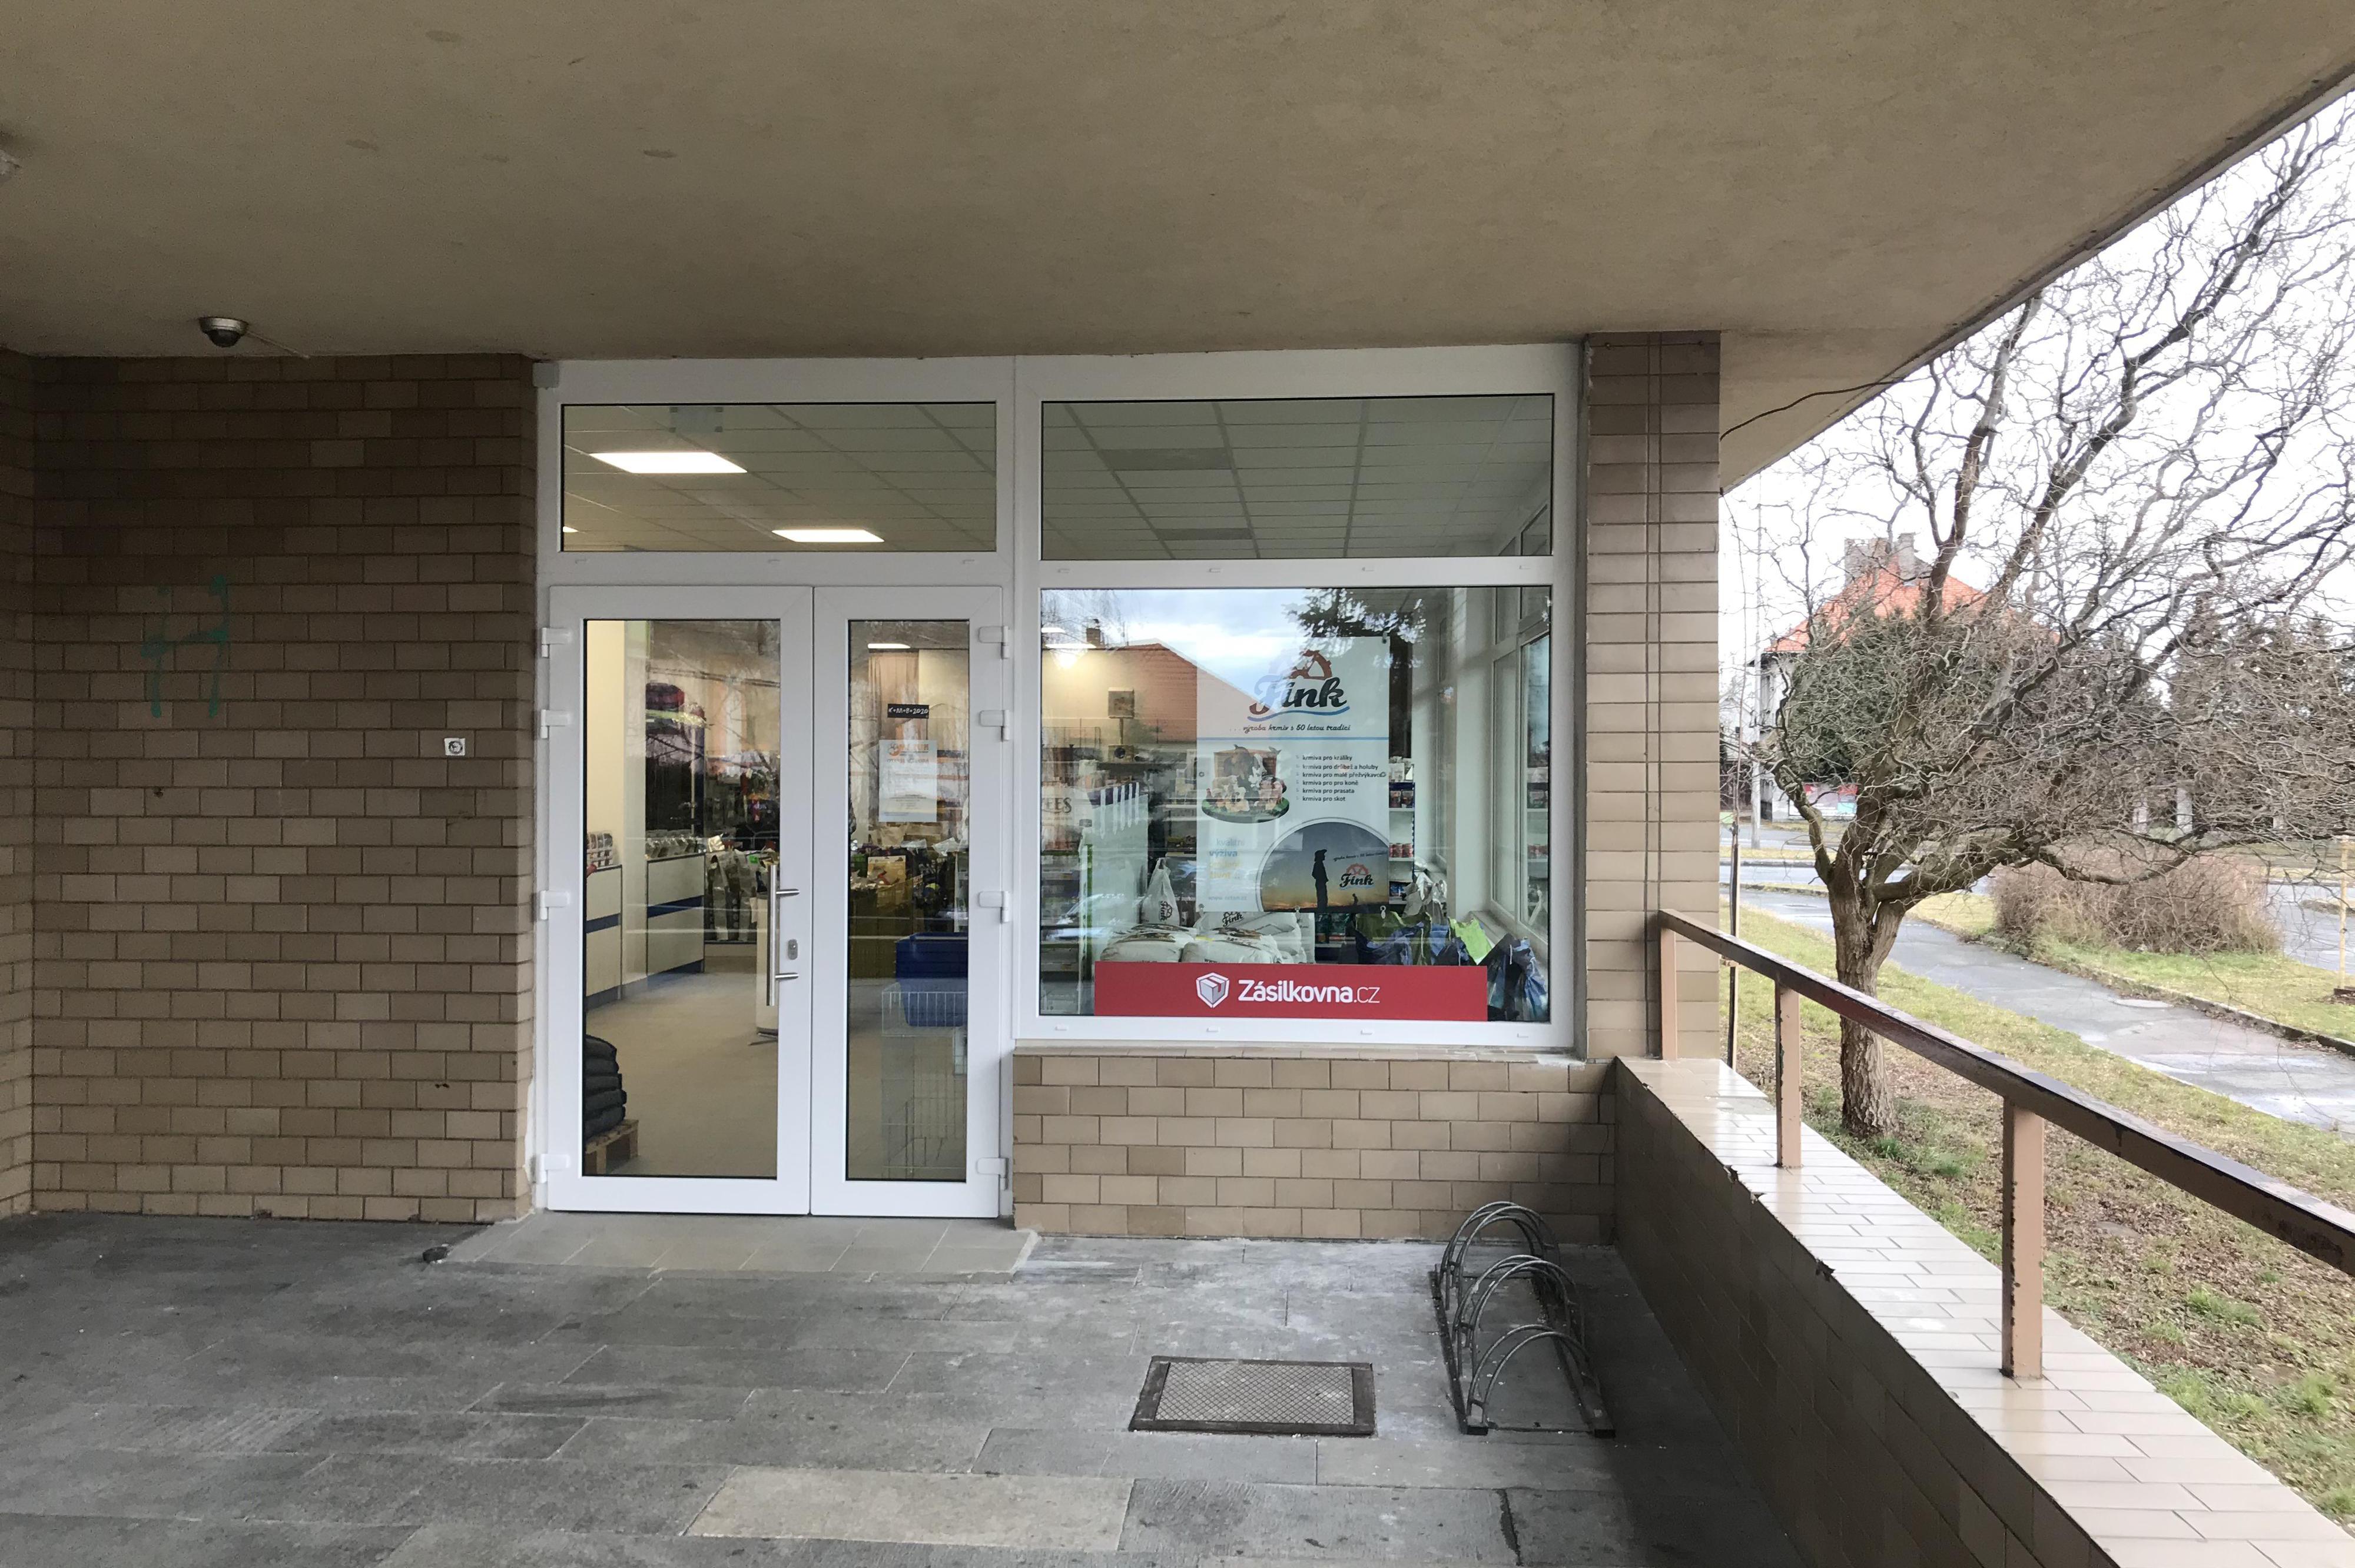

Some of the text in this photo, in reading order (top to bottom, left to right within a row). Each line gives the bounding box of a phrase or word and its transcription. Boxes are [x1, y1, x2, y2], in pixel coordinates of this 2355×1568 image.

[1249, 675, 1347, 715] Fink
[1209, 849, 1238, 858] výživa
[1339, 873, 1374, 888] Fink
[1222, 913, 1244, 927] Fink
